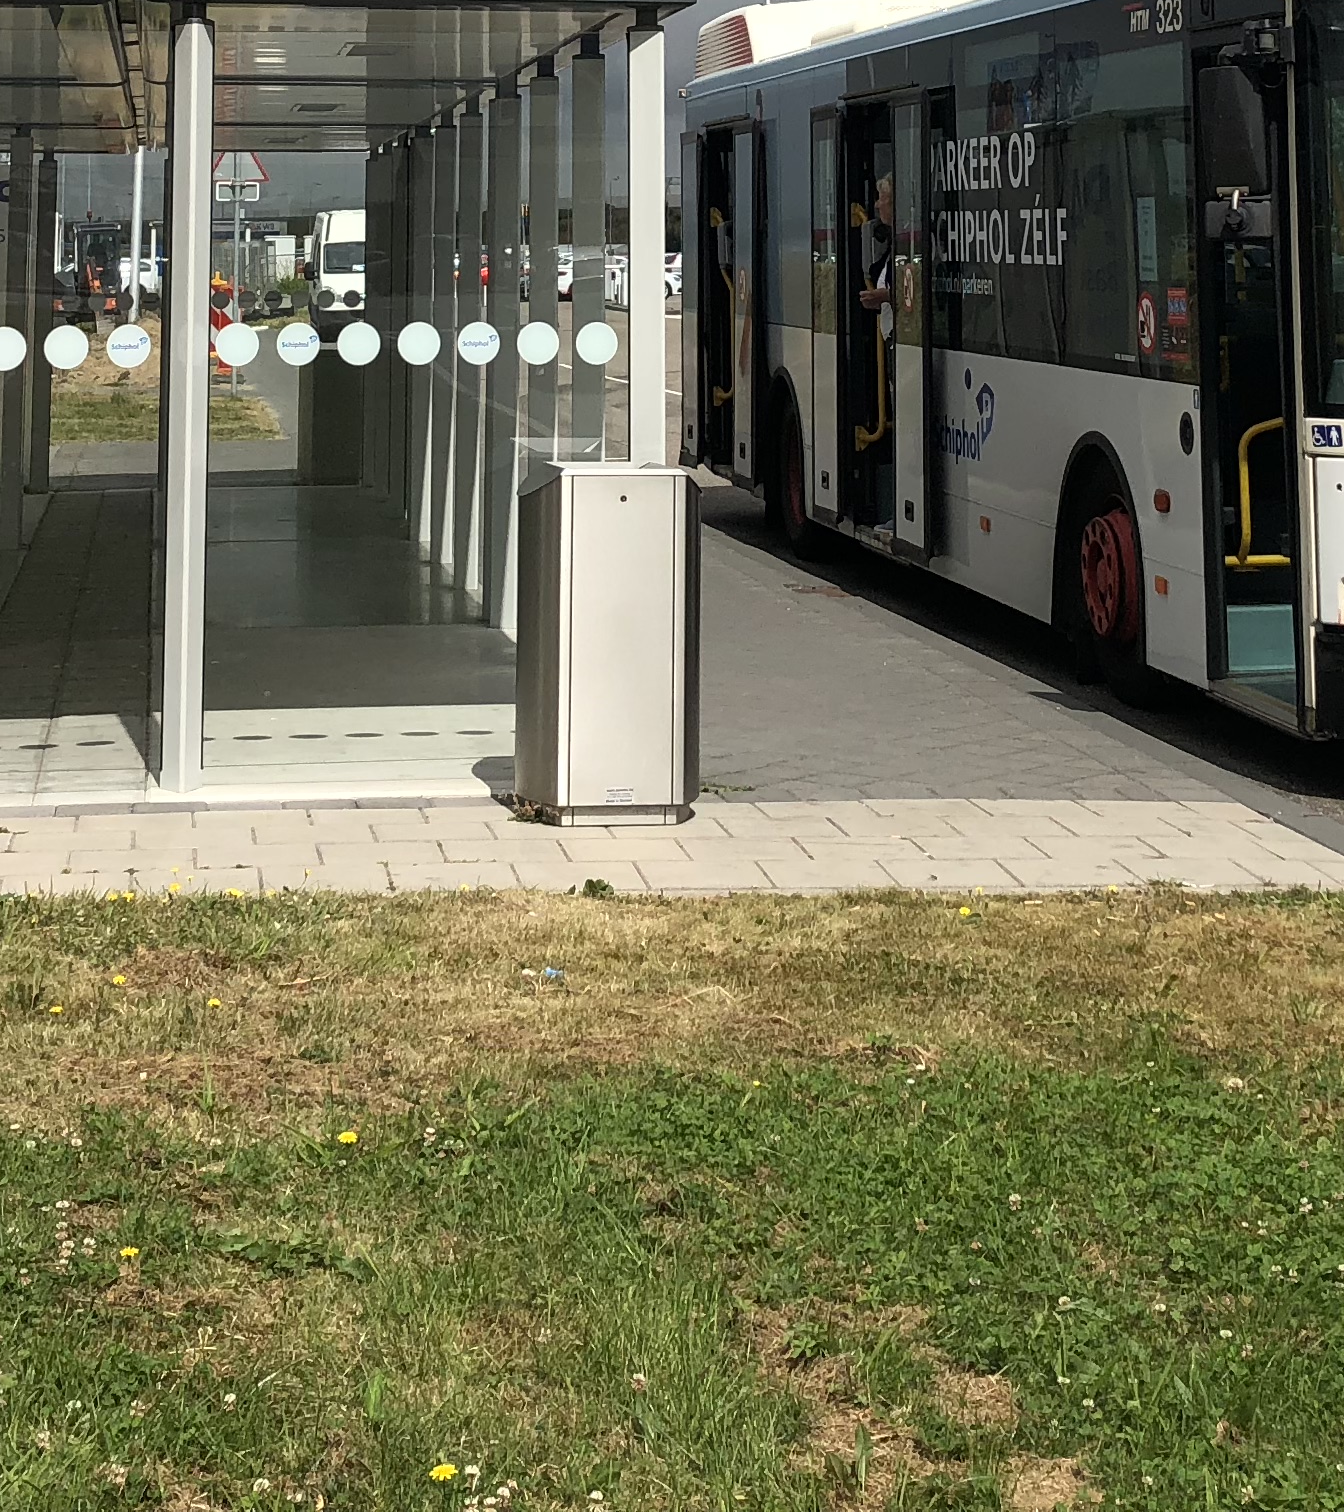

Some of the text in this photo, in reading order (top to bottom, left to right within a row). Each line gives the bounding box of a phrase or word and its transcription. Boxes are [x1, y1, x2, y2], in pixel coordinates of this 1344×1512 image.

[1130, 8, 1150, 33] HTM
[1008, 131, 1036, 189] OP
[1020, 193, 1068, 266] ZÉLF
